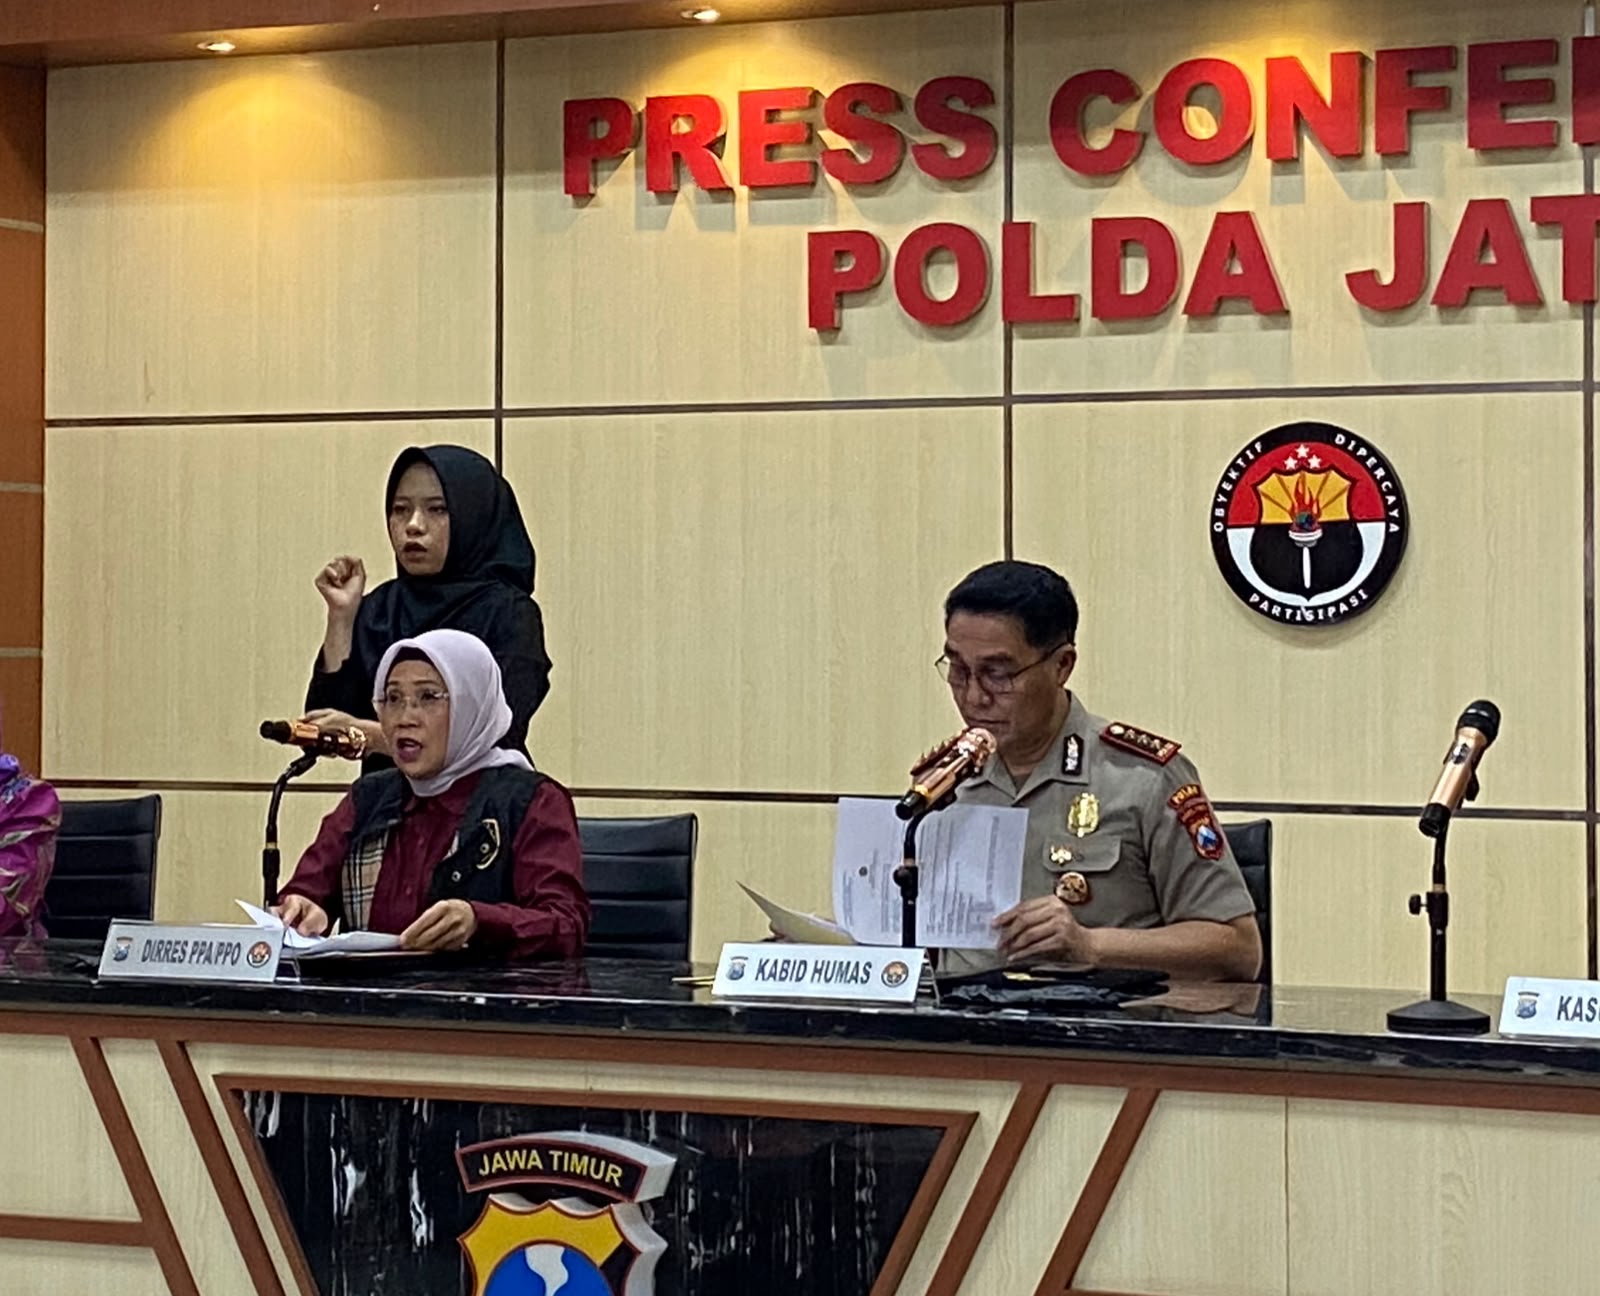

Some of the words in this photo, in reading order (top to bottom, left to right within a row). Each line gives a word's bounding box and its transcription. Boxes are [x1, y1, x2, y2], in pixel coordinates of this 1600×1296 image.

[563, 75, 996, 197] PRESS
[1049, 35, 1600, 176] CONFE
[808, 211, 1290, 330] POLDA
[1213, 441, 1262, 533] OBYEKTIF
[1334, 433, 1401, 533] DIPERCAYA
[1249, 588, 1369, 622] PARTISIPASI
[141, 939, 188, 963] DIRRES
[755, 958, 807, 983] KABID
[810, 959, 872, 984] HUMAS
[1557, 995, 1600, 1022] KAS
[479, 1149, 543, 1176] JAWA
[549, 1150, 623, 1187] TIMUR
